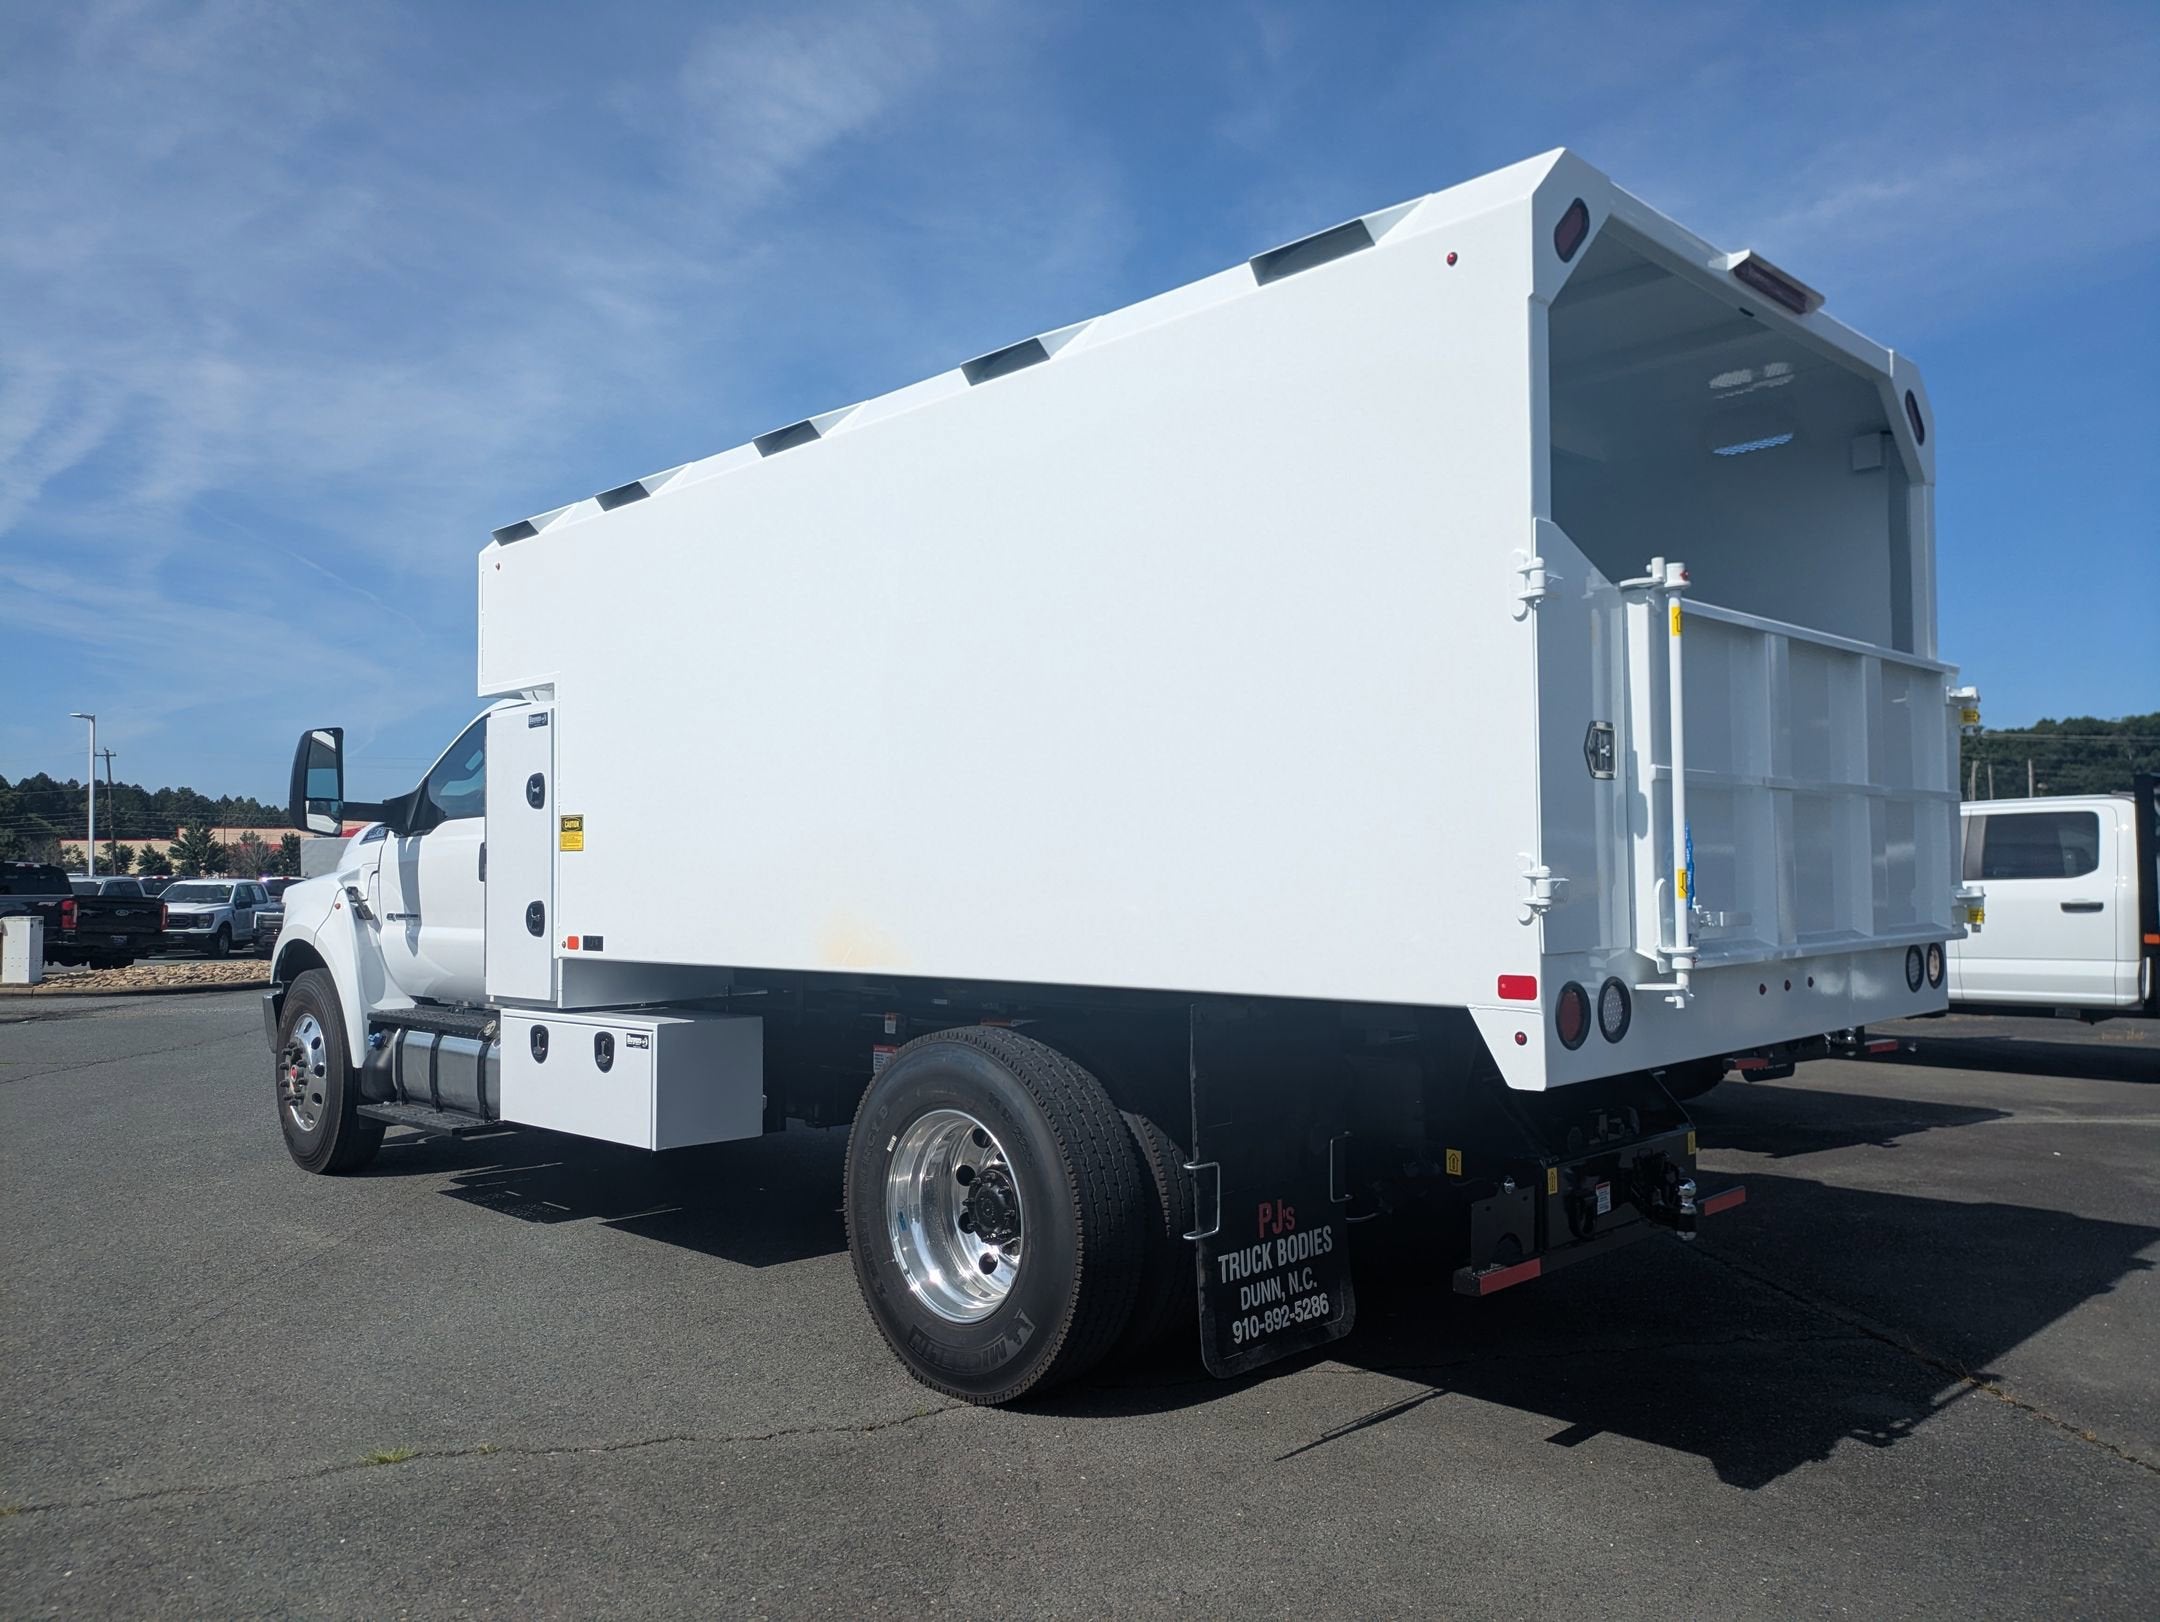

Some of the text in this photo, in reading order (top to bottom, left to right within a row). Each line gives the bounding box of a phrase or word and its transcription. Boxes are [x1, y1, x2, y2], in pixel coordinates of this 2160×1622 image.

[564, 820, 580, 828] CAUTION
[1258, 1200, 1295, 1238] PJ's
[1218, 1225, 1333, 1284] TRUCK BODIES
[1240, 1267, 1318, 1311] DUNN, N.C.
[1232, 1293, 1330, 1345] 910-892-5286
